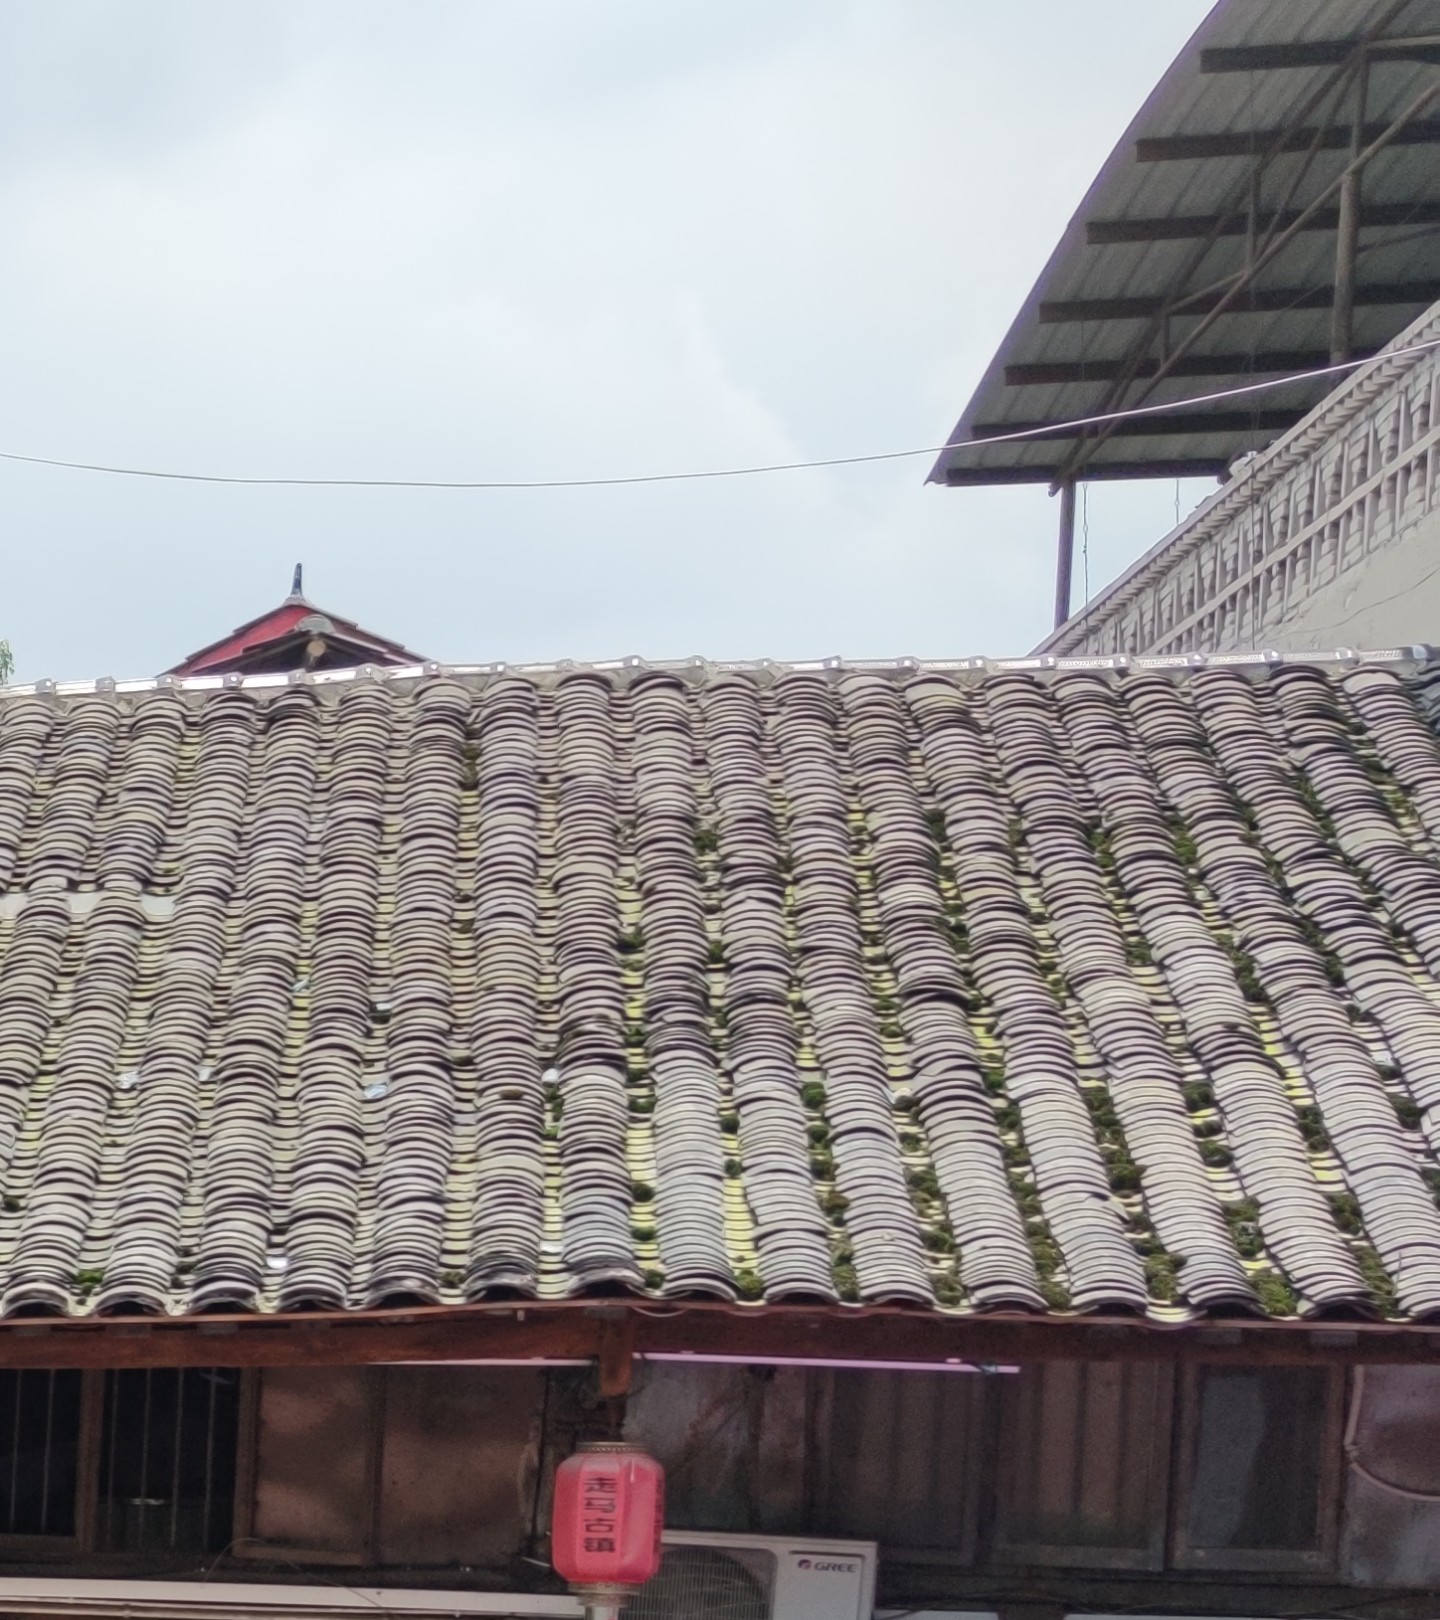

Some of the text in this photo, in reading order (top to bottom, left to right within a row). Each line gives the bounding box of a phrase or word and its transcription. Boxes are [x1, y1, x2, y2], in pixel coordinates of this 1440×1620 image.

[583, 1477, 617, 1553] 走马古镇
[814, 1561, 857, 1573] GREE
